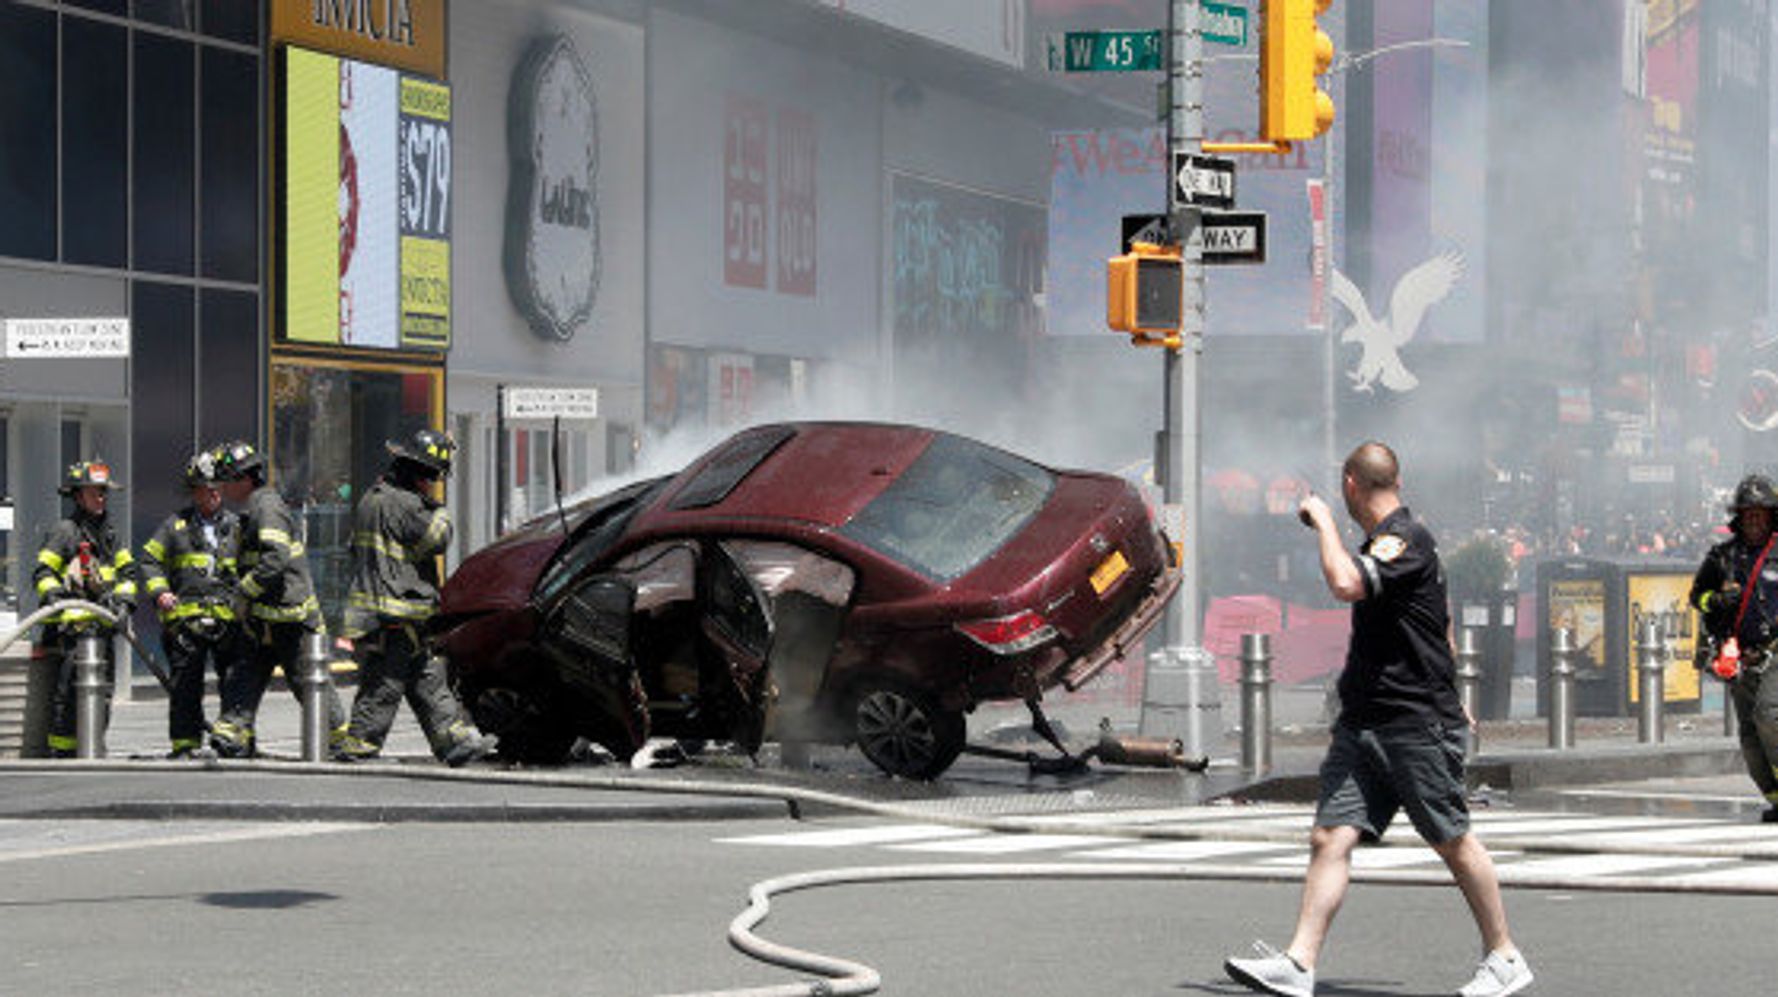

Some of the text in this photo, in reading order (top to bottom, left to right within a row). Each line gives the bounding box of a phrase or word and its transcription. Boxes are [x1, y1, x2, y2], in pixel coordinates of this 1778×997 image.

[1070, 38, 1093, 67] W
[1105, 37, 1133, 65] 45
[408, 121, 450, 234] $79
[1202, 228, 1247, 249] WAY
